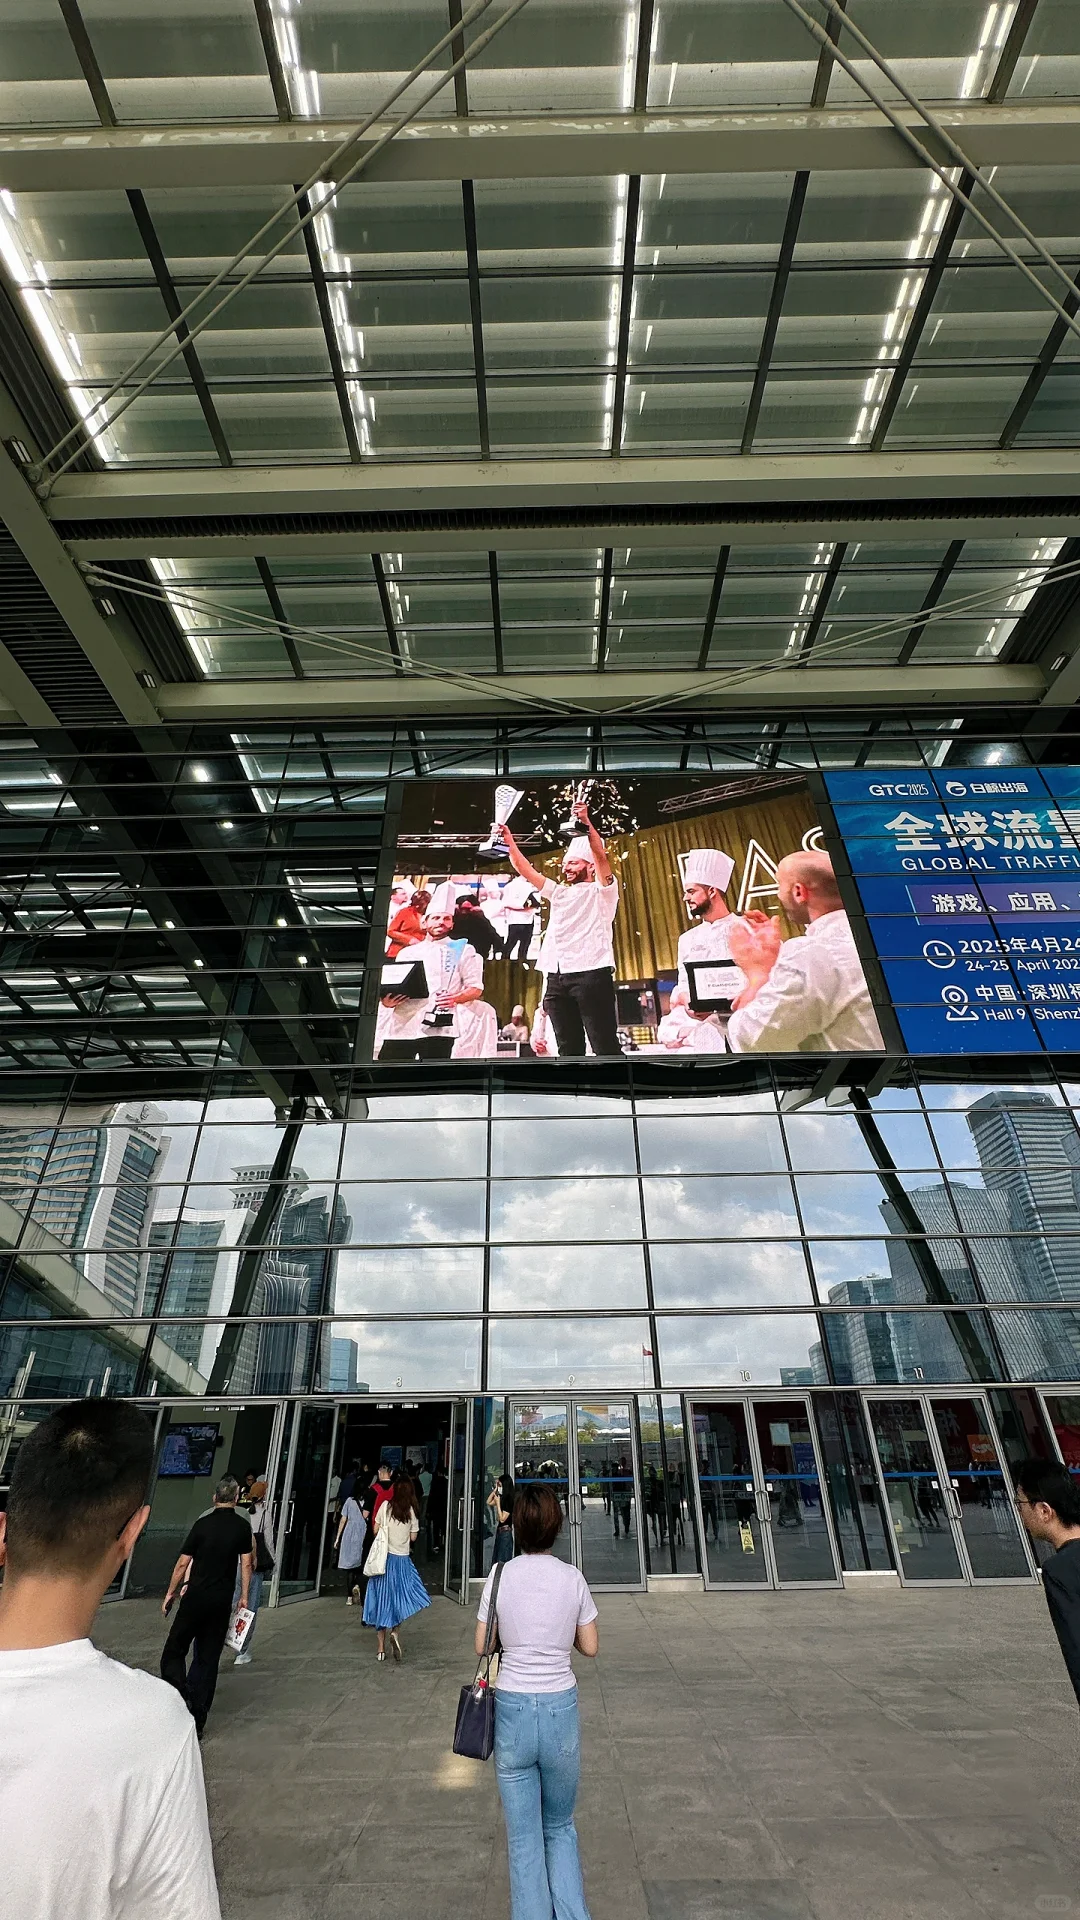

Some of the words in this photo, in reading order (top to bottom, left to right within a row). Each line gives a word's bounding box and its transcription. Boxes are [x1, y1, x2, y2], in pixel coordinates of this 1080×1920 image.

[884, 809, 1080, 851] 全球流量
[901, 856, 996, 871] GLOBAL
[1000, 855, 1080, 869] TRAFFI
[965, 960, 1009, 971] 24-25
[1017, 959, 1050, 973] April
[1052, 959, 1080, 970] 202
[983, 1008, 1014, 1020] Hall
[1016, 1008, 1026, 1020] 9
[1033, 1007, 1080, 1020] Shenz
[740, 1370, 751, 1382] 10
[913, 1367, 925, 1379] 11
[223, 1380, 230, 1391] 7
